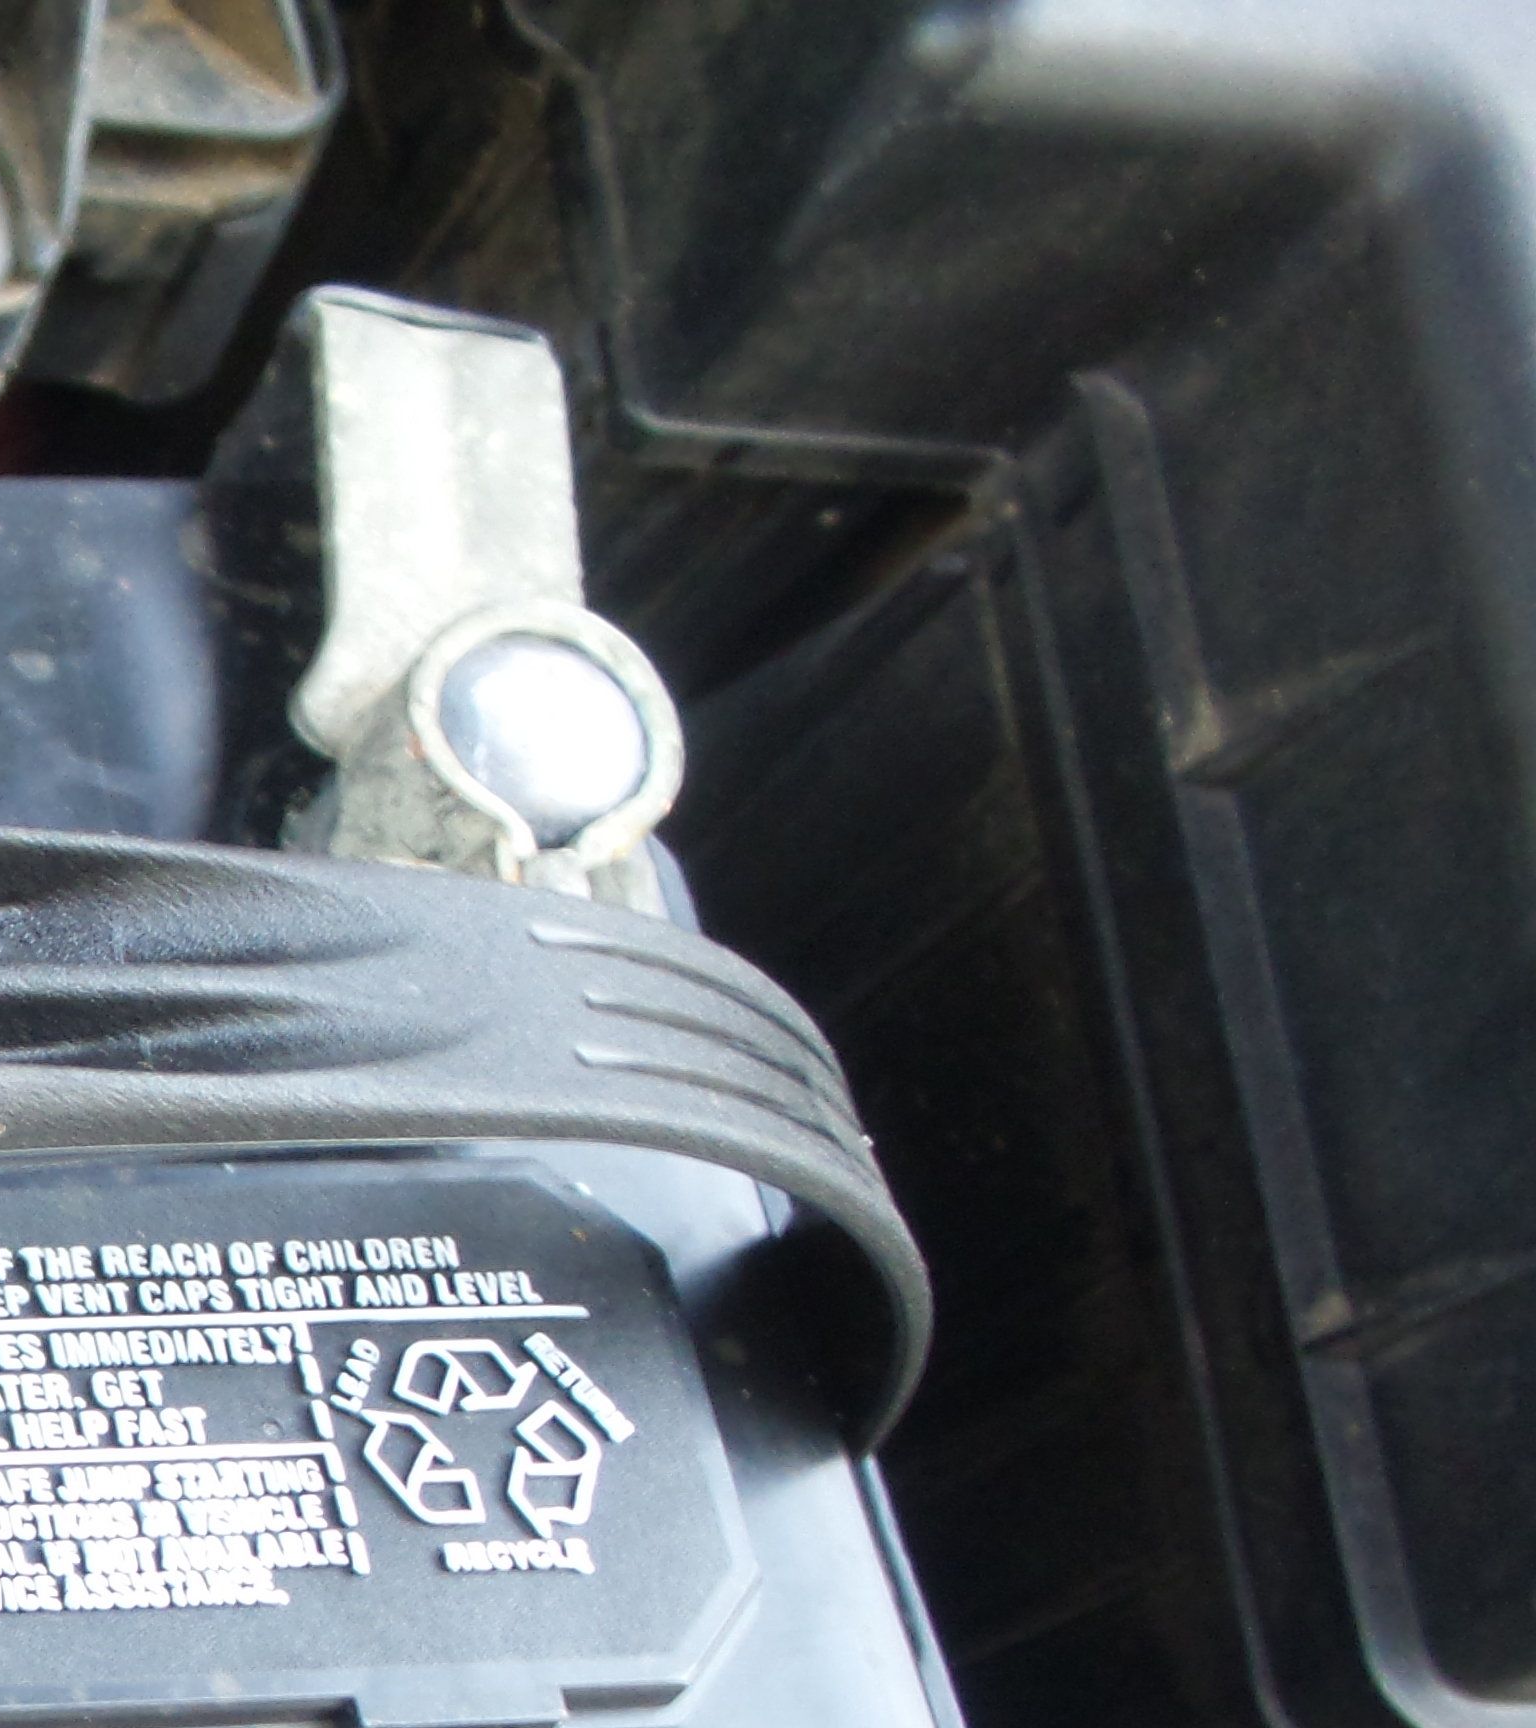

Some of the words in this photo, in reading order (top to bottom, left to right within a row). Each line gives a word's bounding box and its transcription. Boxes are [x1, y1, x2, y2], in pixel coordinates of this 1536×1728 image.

[19, 1246, 95, 1281] THE
[98, 1243, 221, 1279] REACH
[227, 1241, 277, 1276] OF
[283, 1237, 460, 1273] CHILDREN
[34, 1283, 129, 1315] VENT
[140, 1279, 232, 1313] CAPS
[236, 1275, 344, 1309] TIGHT
[355, 1275, 428, 1307] AND
[435, 1271, 544, 1306] LEVEL
[47, 1326, 295, 1370] IMMEDIATELY
[92, 1370, 164, 1409] GET
[331, 1338, 381, 1413] LEAD
[523, 1331, 635, 1444] RETURN
[12, 1411, 110, 1450] HELP
[112, 1407, 208, 1447] FAST
[152, 1458, 325, 1501] STARTING
